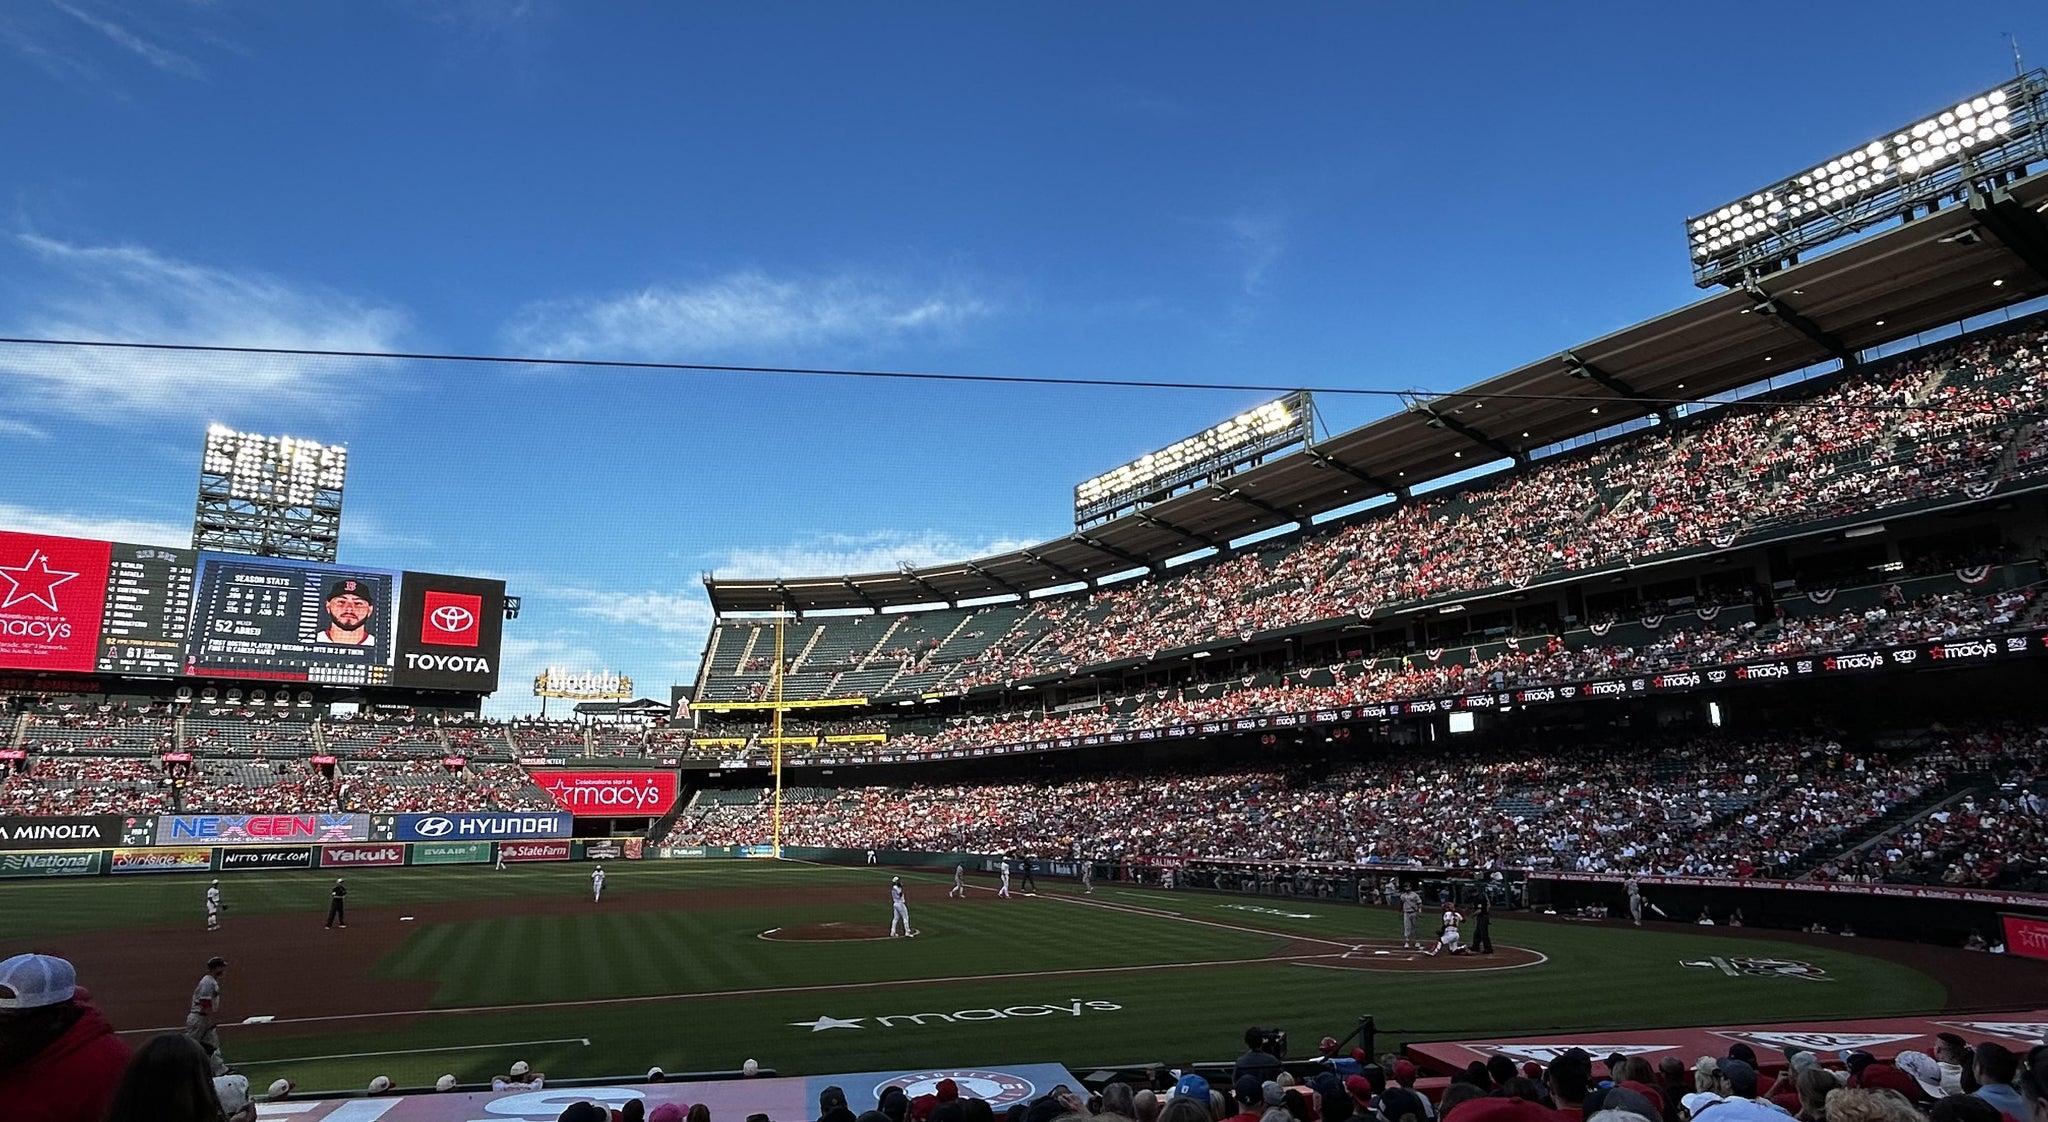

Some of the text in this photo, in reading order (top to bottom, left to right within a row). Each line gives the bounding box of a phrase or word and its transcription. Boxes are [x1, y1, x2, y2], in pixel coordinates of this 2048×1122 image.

[235, 575, 290, 585] SEASON STATS
[214, 619, 233, 633] 52
[234, 627, 261, 636] ABREU
[251, 642, 273, 650] PLAYER
[126, 647, 141, 659] 61
[405, 653, 491, 674] TOYOTA
[548, 664, 619, 693] Modelo
[145, 819, 154, 828] 4
[172, 817, 316, 838] NEXGEN
[388, 817, 395, 825] 0
[459, 817, 558, 835] HYUNDAI
[13, 825, 101, 839] MINOLTA
[387, 832, 393, 840] 0
[145, 835, 150, 845] 1
[23, 854, 93, 868] National
[117, 852, 176, 867] Surfside
[225, 852, 309, 863] NITTO TIRE.COM
[328, 848, 398, 862] Yakult
